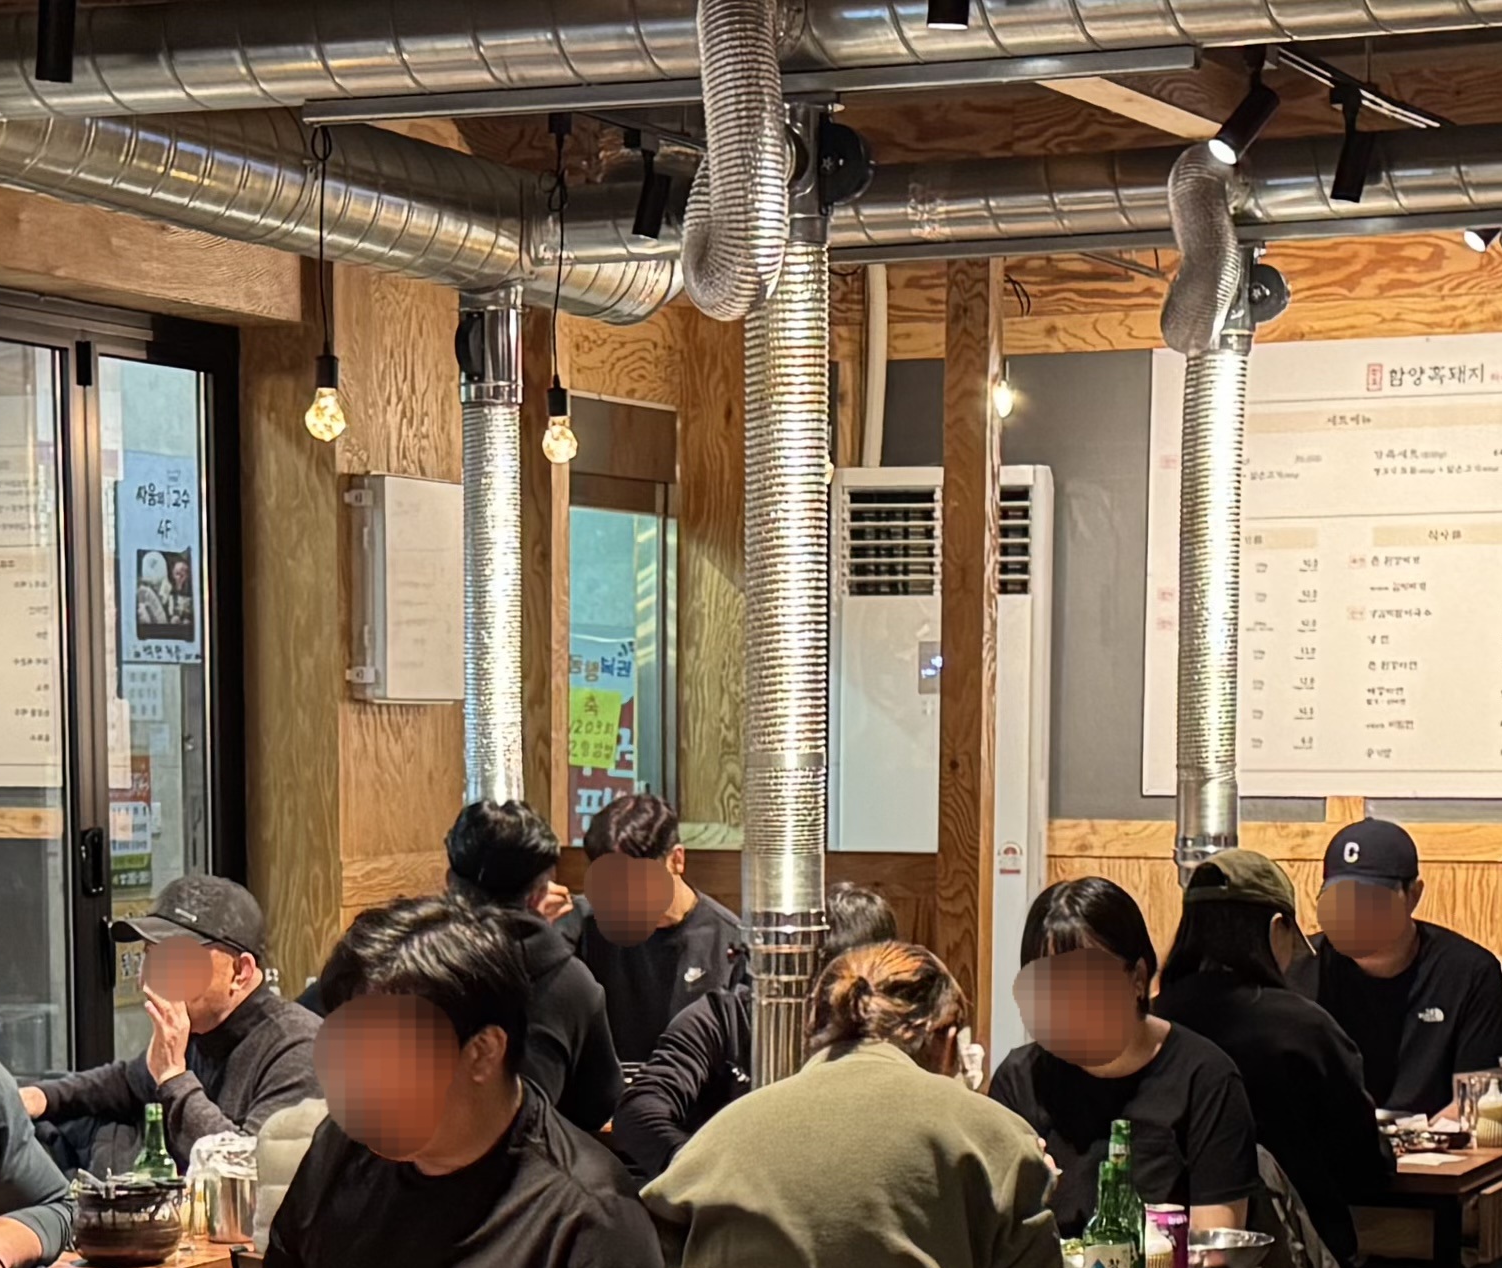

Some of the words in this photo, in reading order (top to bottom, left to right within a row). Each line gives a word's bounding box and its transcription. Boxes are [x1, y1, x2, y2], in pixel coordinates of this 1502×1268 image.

[1389, 363, 1485, 388] 함양흑돼지
[171, 489, 190, 509] 고수
[157, 518, 172, 539] 4F
[1344, 841, 1359, 863] C
